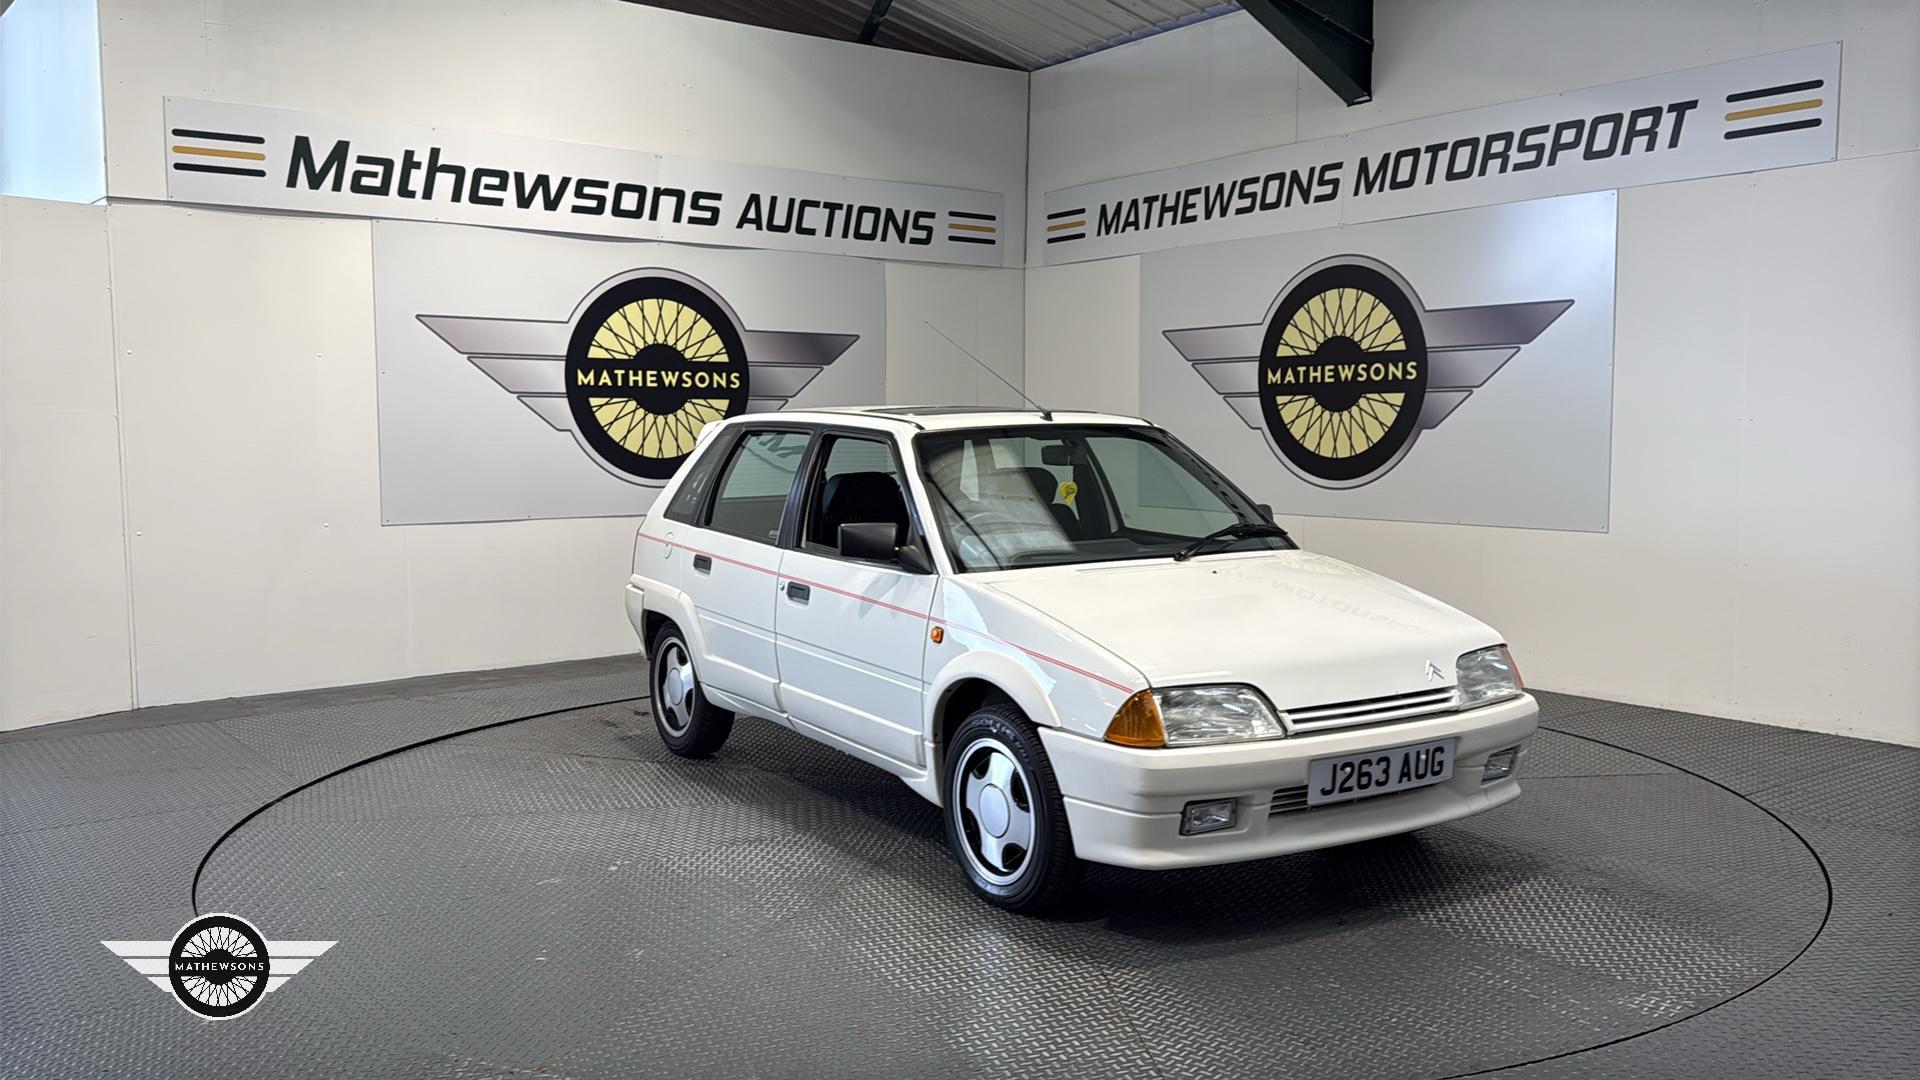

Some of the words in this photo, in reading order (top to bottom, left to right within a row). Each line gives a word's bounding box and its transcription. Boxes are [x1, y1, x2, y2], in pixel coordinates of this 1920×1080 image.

[285, 135, 723, 227] Mathewsons
[735, 193, 937, 246] AUCTIONS
[1096, 161, 1345, 237] MATHEWSONS
[1352, 99, 1700, 196] MOTORSPORT
[576, 368, 741, 389] MATHEWSONS
[1267, 361, 1418, 385] MATHEWSONS
[1320, 756, 1391, 796] J263
[1397, 746, 1445, 784] AUG
